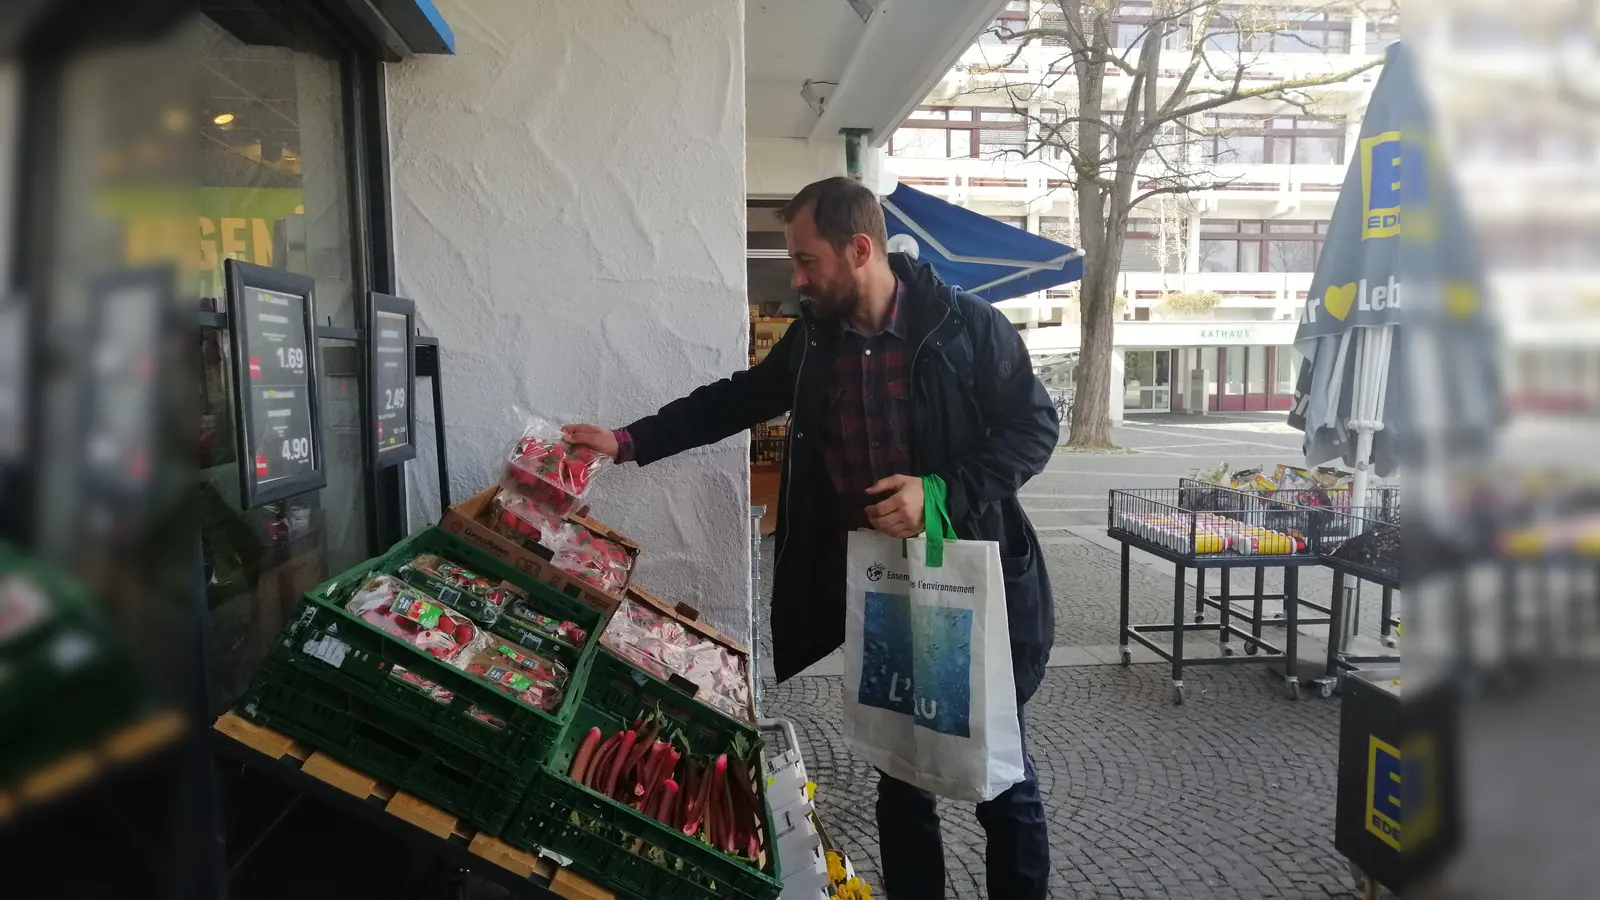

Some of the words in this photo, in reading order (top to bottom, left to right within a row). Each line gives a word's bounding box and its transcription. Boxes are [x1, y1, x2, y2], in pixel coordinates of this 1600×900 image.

[1368, 212, 1400, 229] ED
[1200, 329, 1250, 338] RATHAUS
[276, 346, 304, 369] 1.69
[385, 387, 405, 410] 2.49
[282, 437, 309, 460] 4.90
